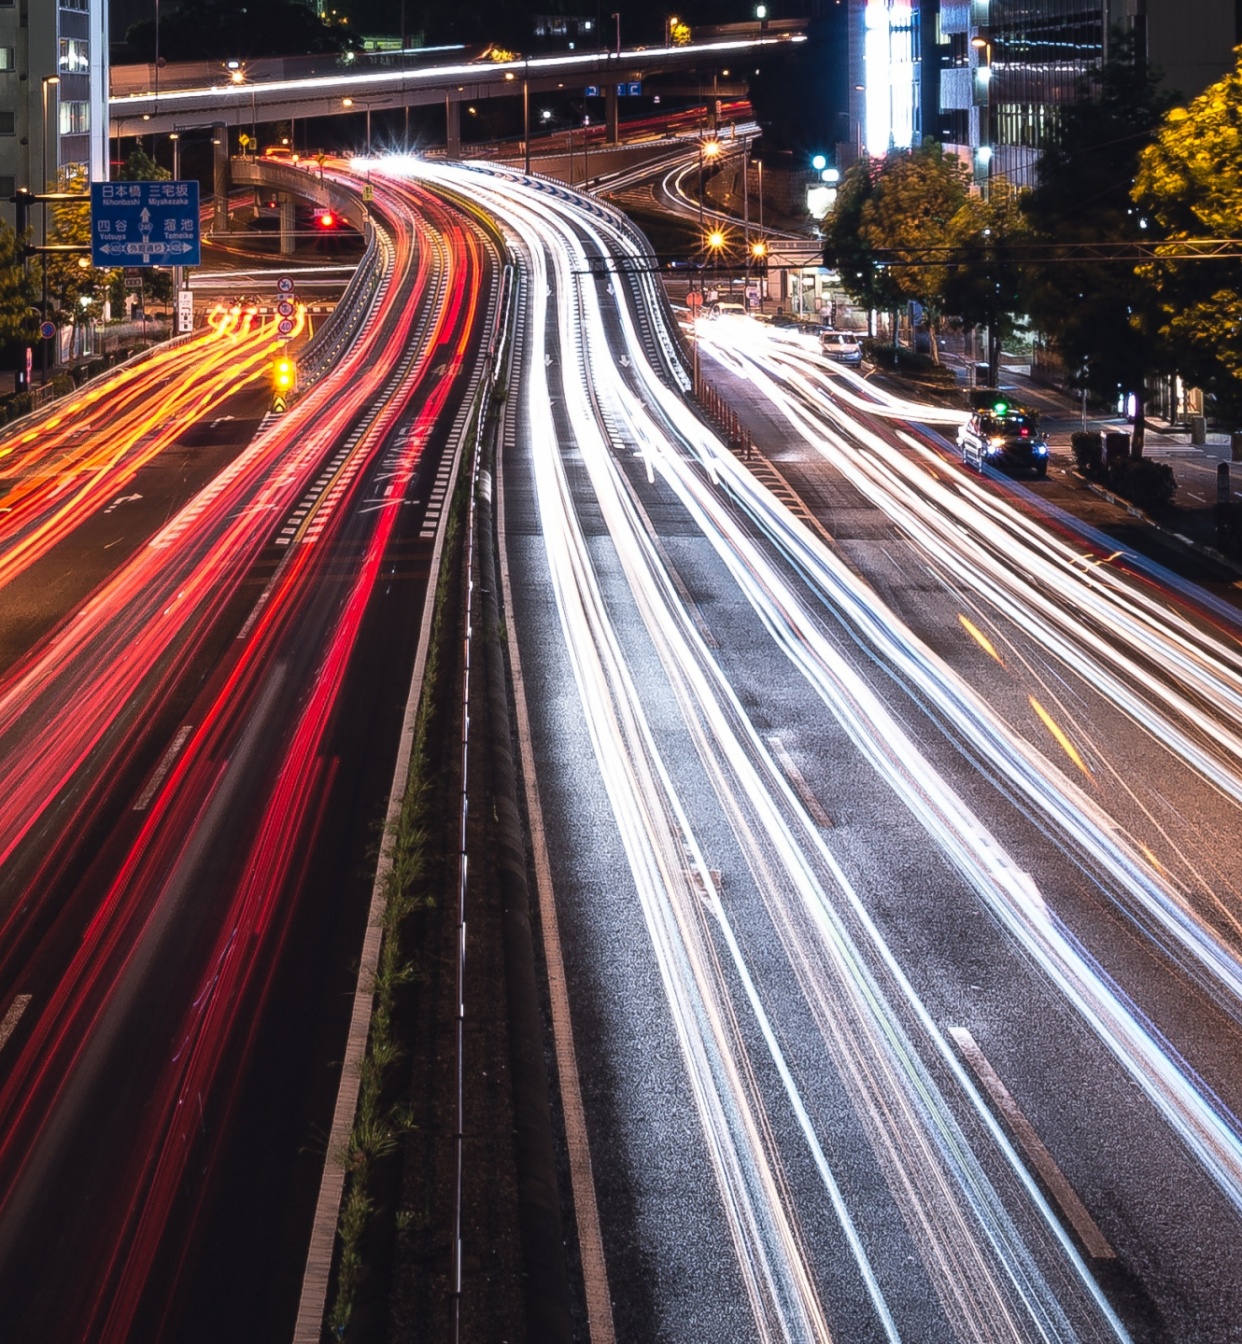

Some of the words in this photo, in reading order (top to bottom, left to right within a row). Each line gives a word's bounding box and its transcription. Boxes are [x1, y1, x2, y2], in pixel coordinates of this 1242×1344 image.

[102, 185, 141, 198] 日本橋
[149, 184, 188, 197] 三宅坂
[103, 198, 140, 206] Nihonbashi
[148, 198, 189, 207] Miyakezaka
[98, 220, 128, 232] 四谷
[164, 218, 194, 232] 溜池
[99, 233, 127, 241] Yotsuya
[281, 322, 291, 331] 40
